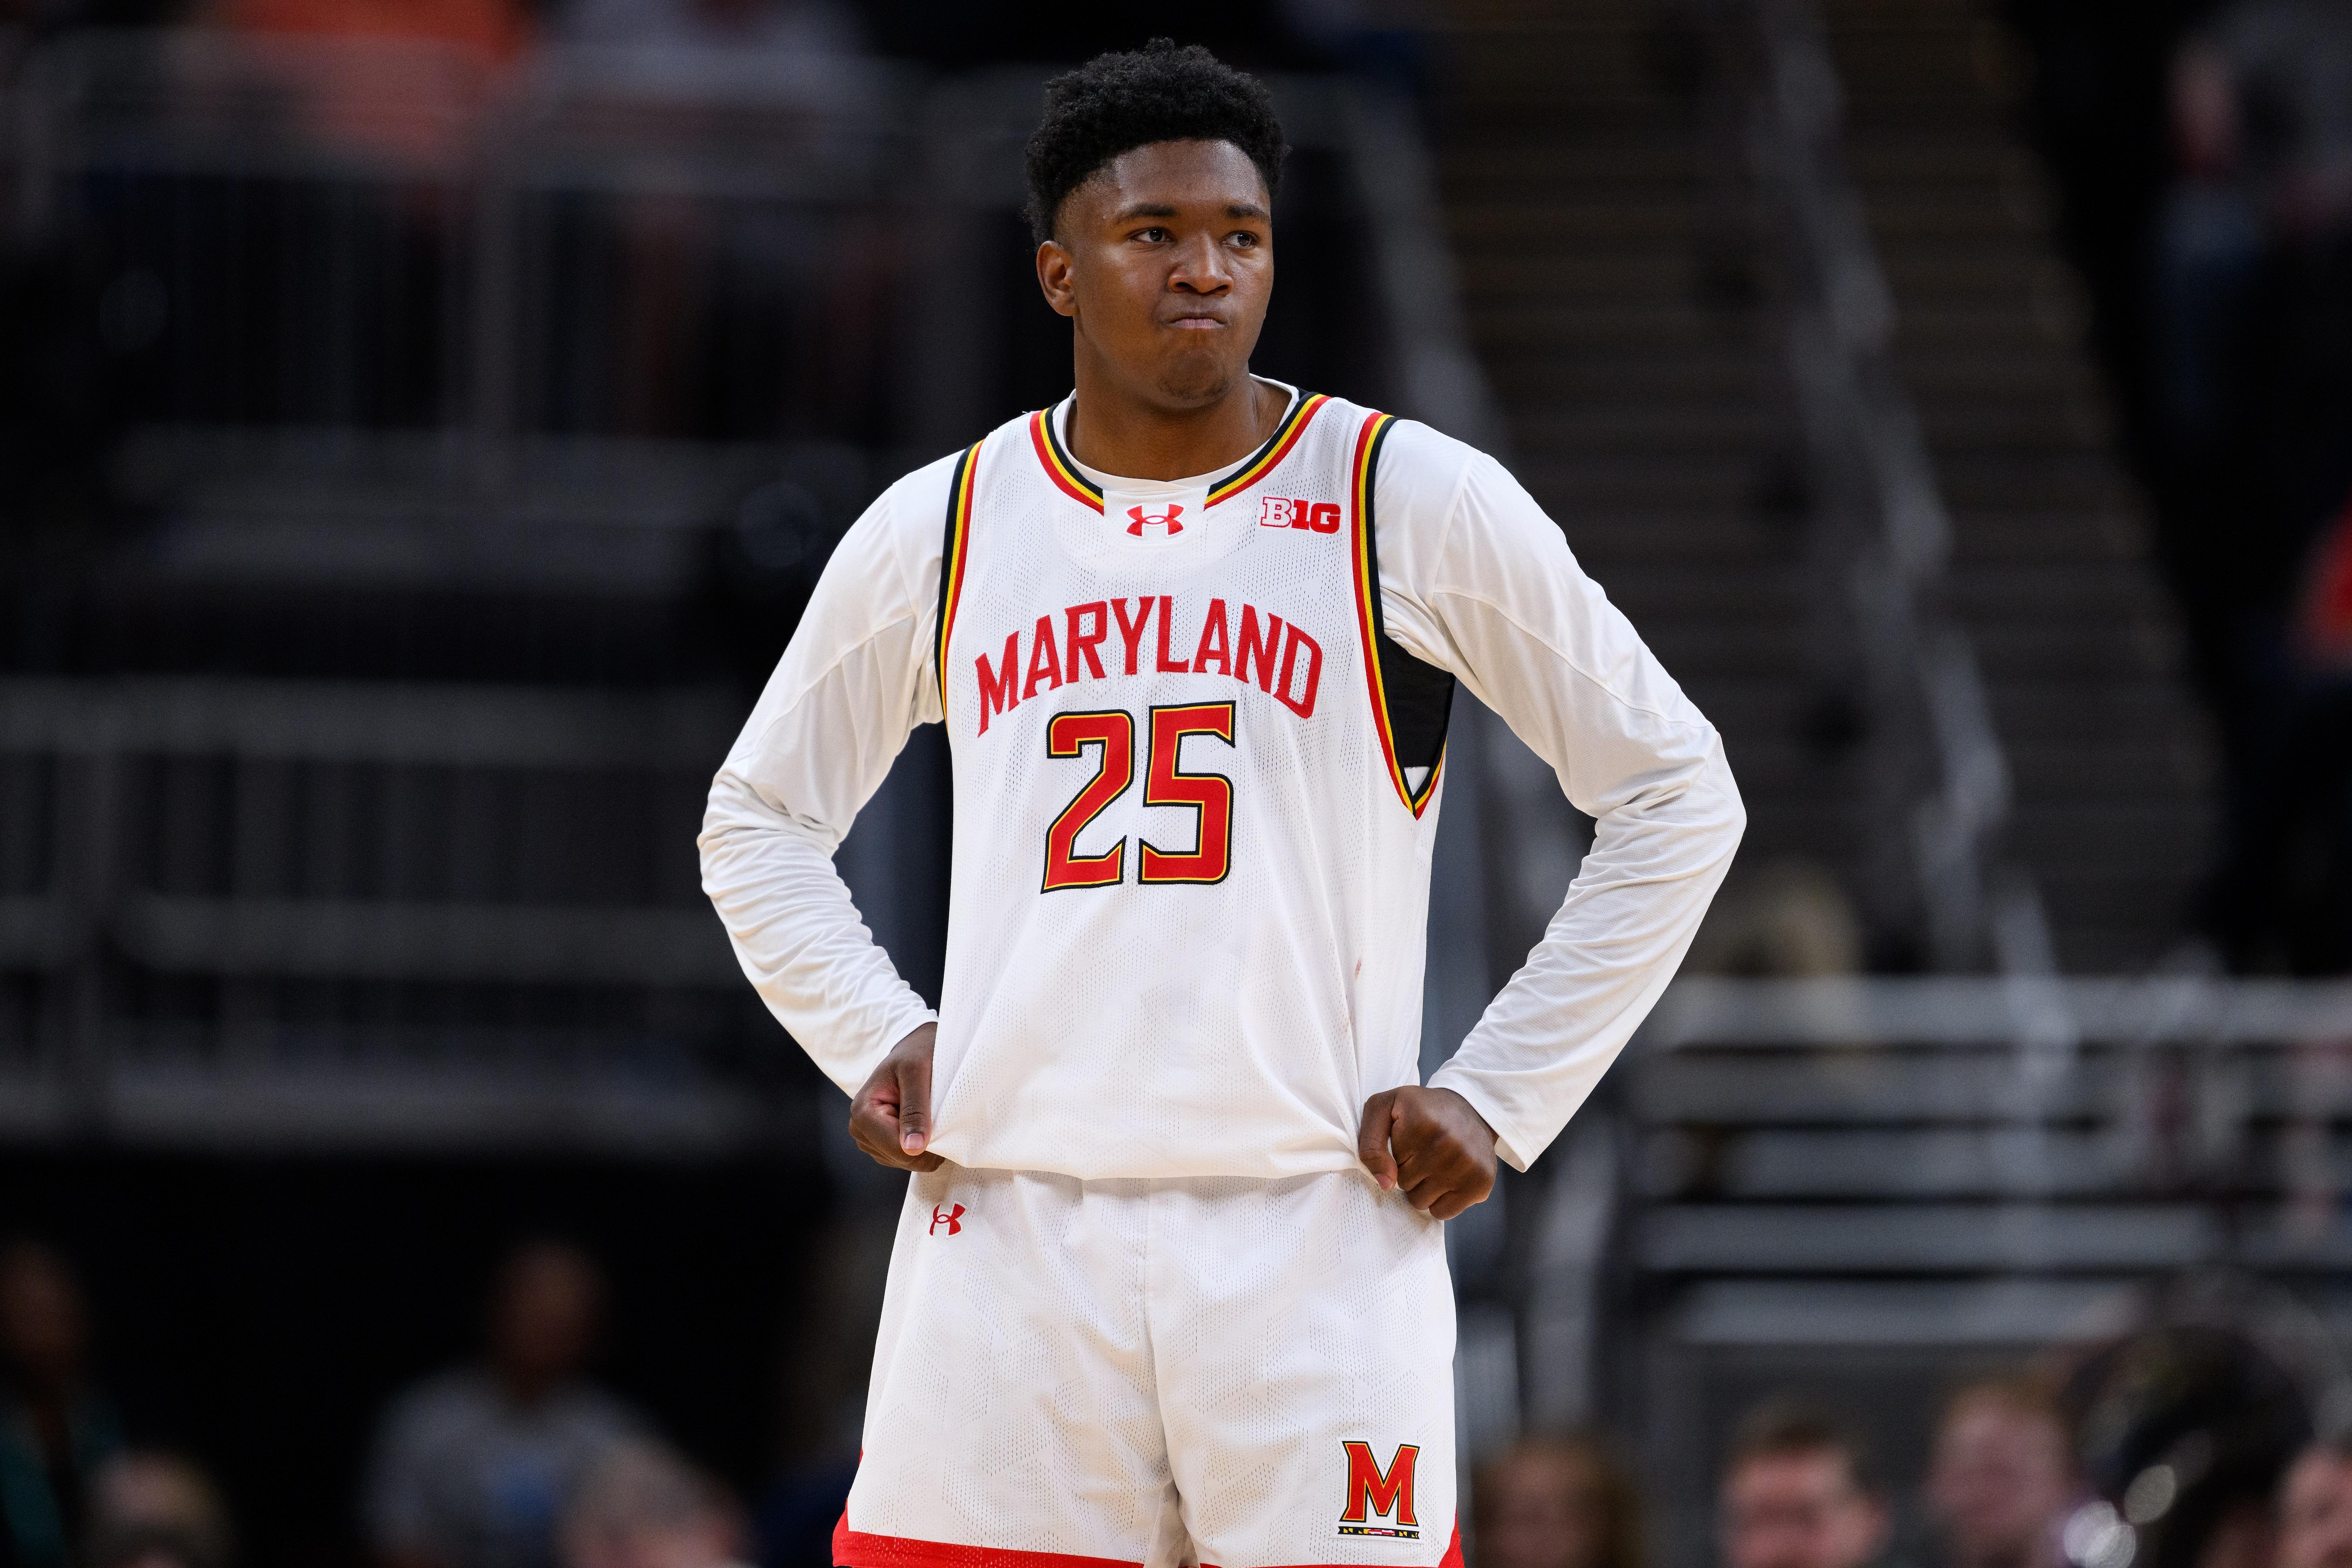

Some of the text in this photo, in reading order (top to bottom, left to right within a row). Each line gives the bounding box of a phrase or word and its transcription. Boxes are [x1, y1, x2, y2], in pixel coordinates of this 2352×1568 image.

[974, 595, 1323, 738] MARYLAND
[1040, 700, 1237, 895] 25
[1339, 1441, 1421, 1527] M
